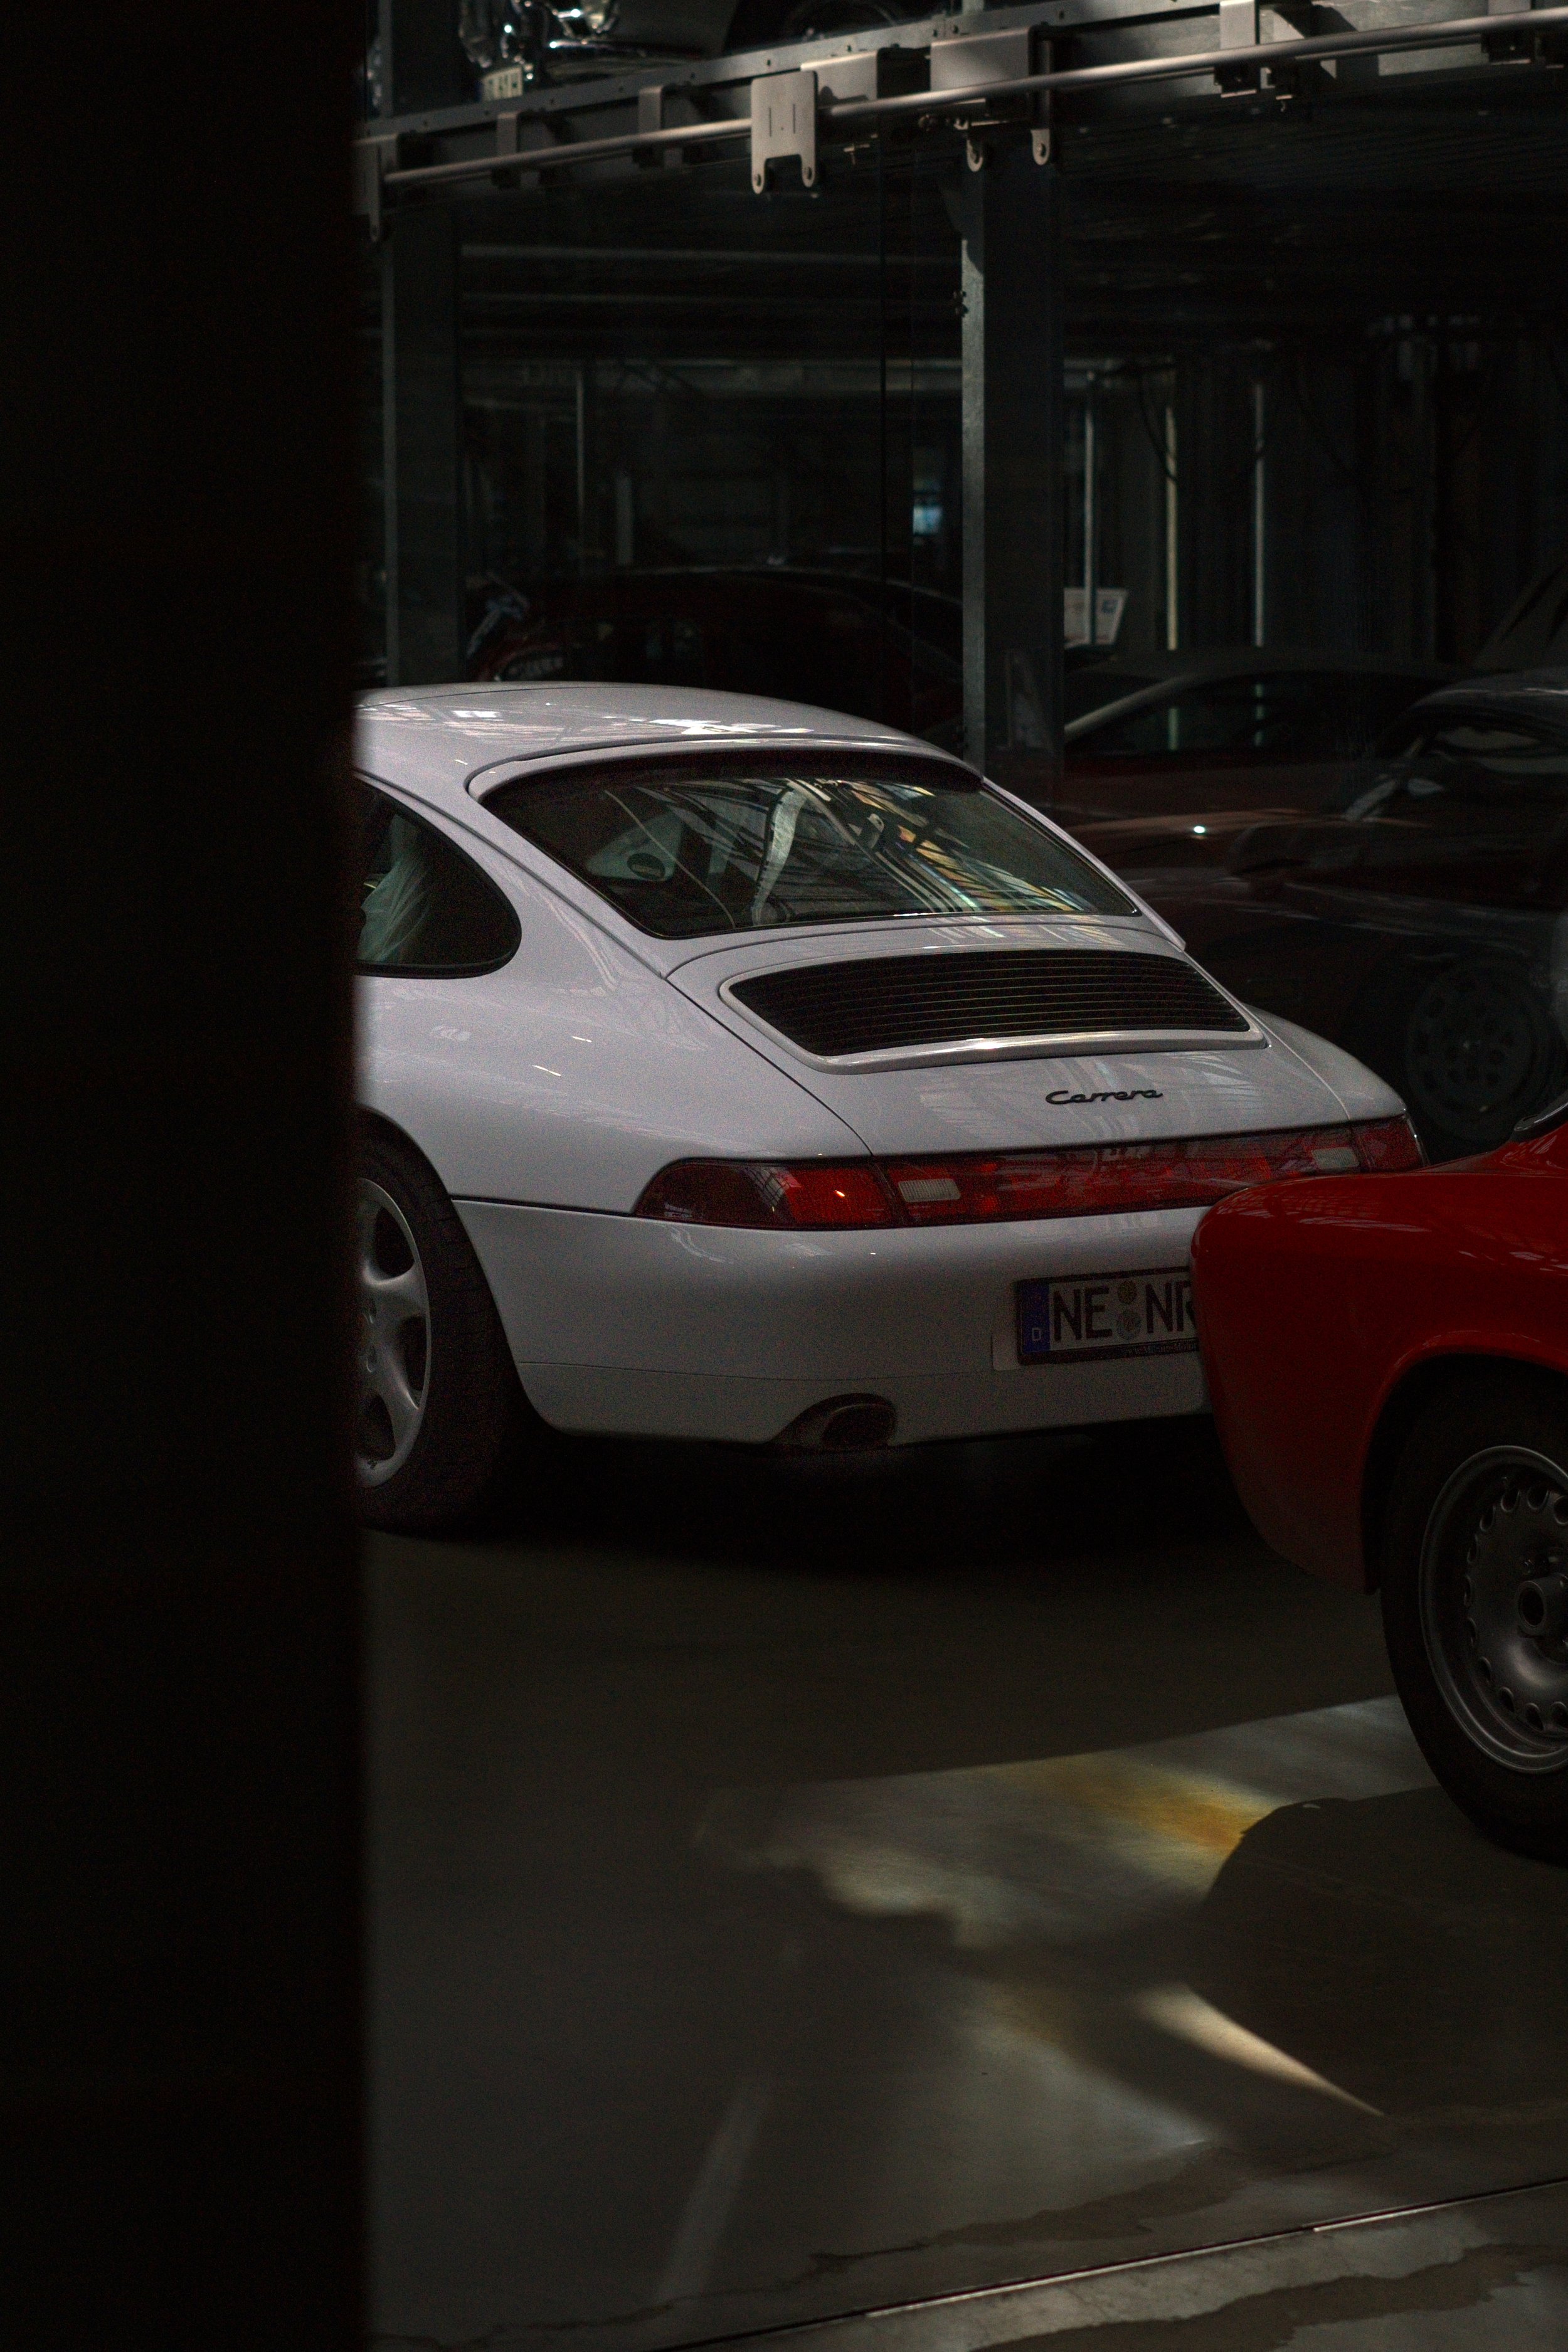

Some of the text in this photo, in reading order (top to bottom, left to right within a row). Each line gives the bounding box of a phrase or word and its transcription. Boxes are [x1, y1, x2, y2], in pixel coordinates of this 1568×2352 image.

[1046, 1089, 1163, 1105] Carrera
[1054, 1286, 1113, 1342] NE
[1032, 1328, 1041, 1341] D
